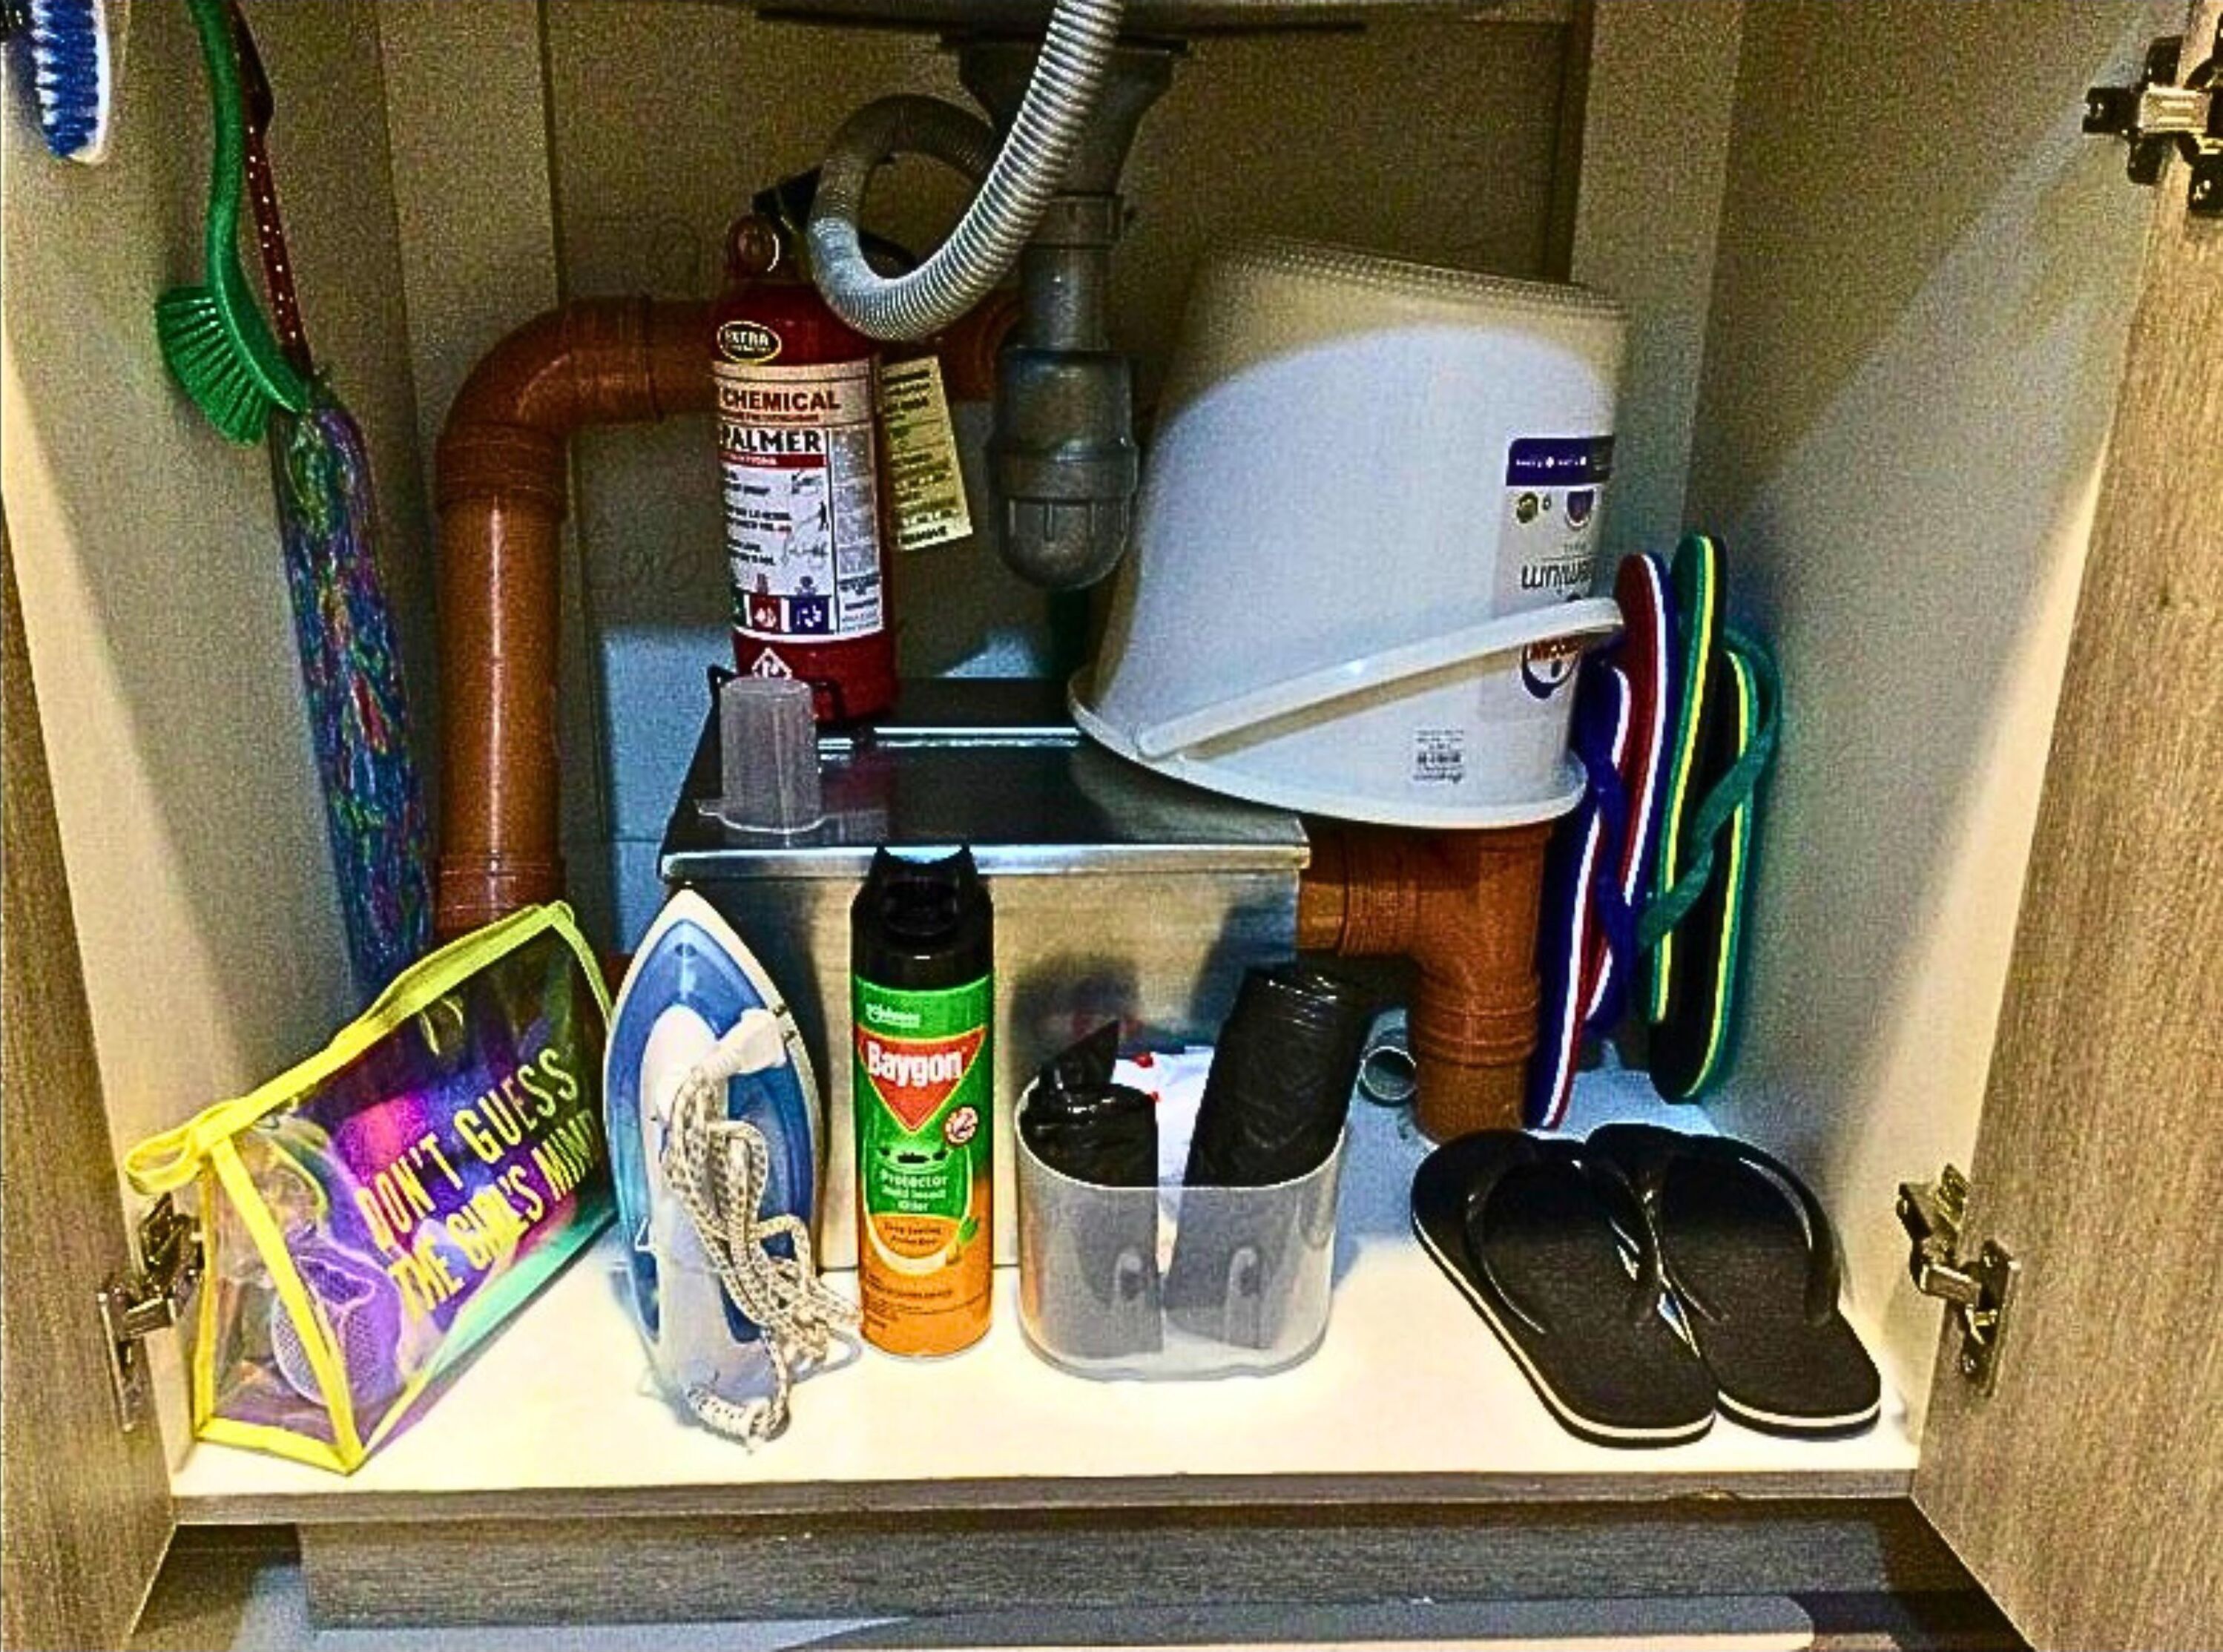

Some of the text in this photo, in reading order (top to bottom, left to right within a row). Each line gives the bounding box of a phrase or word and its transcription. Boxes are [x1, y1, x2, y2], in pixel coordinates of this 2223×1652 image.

[723, 387, 840, 412] CHEMICAL
[722, 424, 821, 453] PALMER
[867, 1041, 963, 1087] Baygon
[355, 1048, 577, 1253] DON'T GUESS
[879, 1168, 948, 1187] Protector
[388, 1236, 465, 1323] THE
